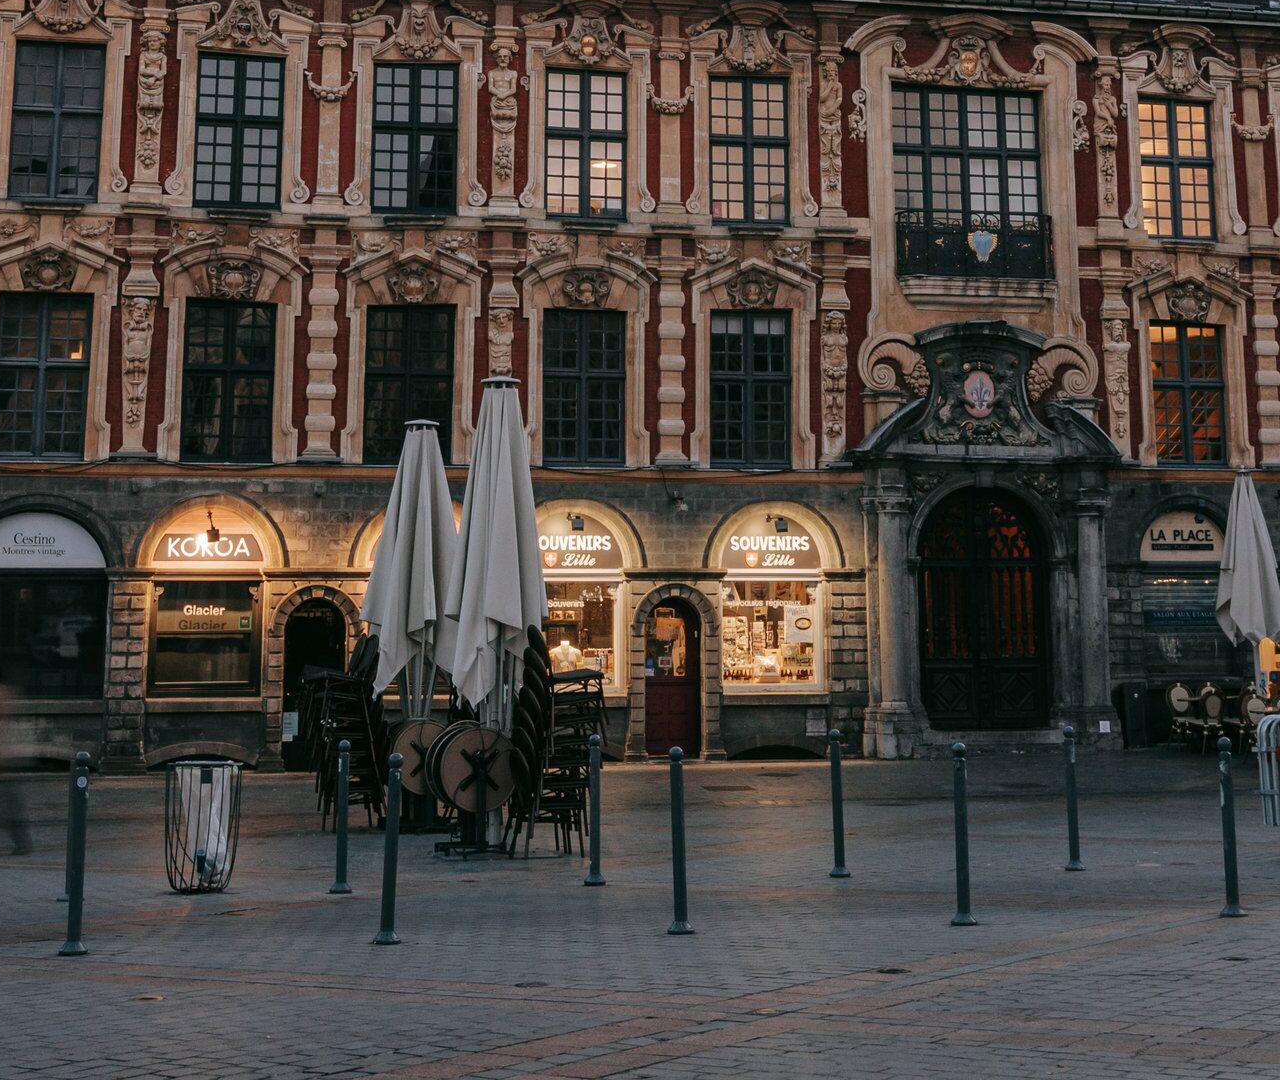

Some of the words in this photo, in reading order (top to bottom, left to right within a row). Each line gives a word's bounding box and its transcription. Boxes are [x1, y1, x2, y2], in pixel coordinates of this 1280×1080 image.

[13, 532, 56, 545] Cestino
[1150, 529, 1166, 542] LA
[1173, 529, 1213, 542] PLACE
[167, 536, 250, 557] KOKOA
[538, 535, 612, 551] OUVENIRS
[730, 535, 810, 551] SOUVENIRS
[2, 546, 36, 556] Montres
[37, 547, 66, 557] vintage
[561, 553, 596, 567] Lille
[761, 553, 796, 567] Lille
[183, 604, 226, 616] Glacier
[547, 599, 585, 608] Souvenirs
